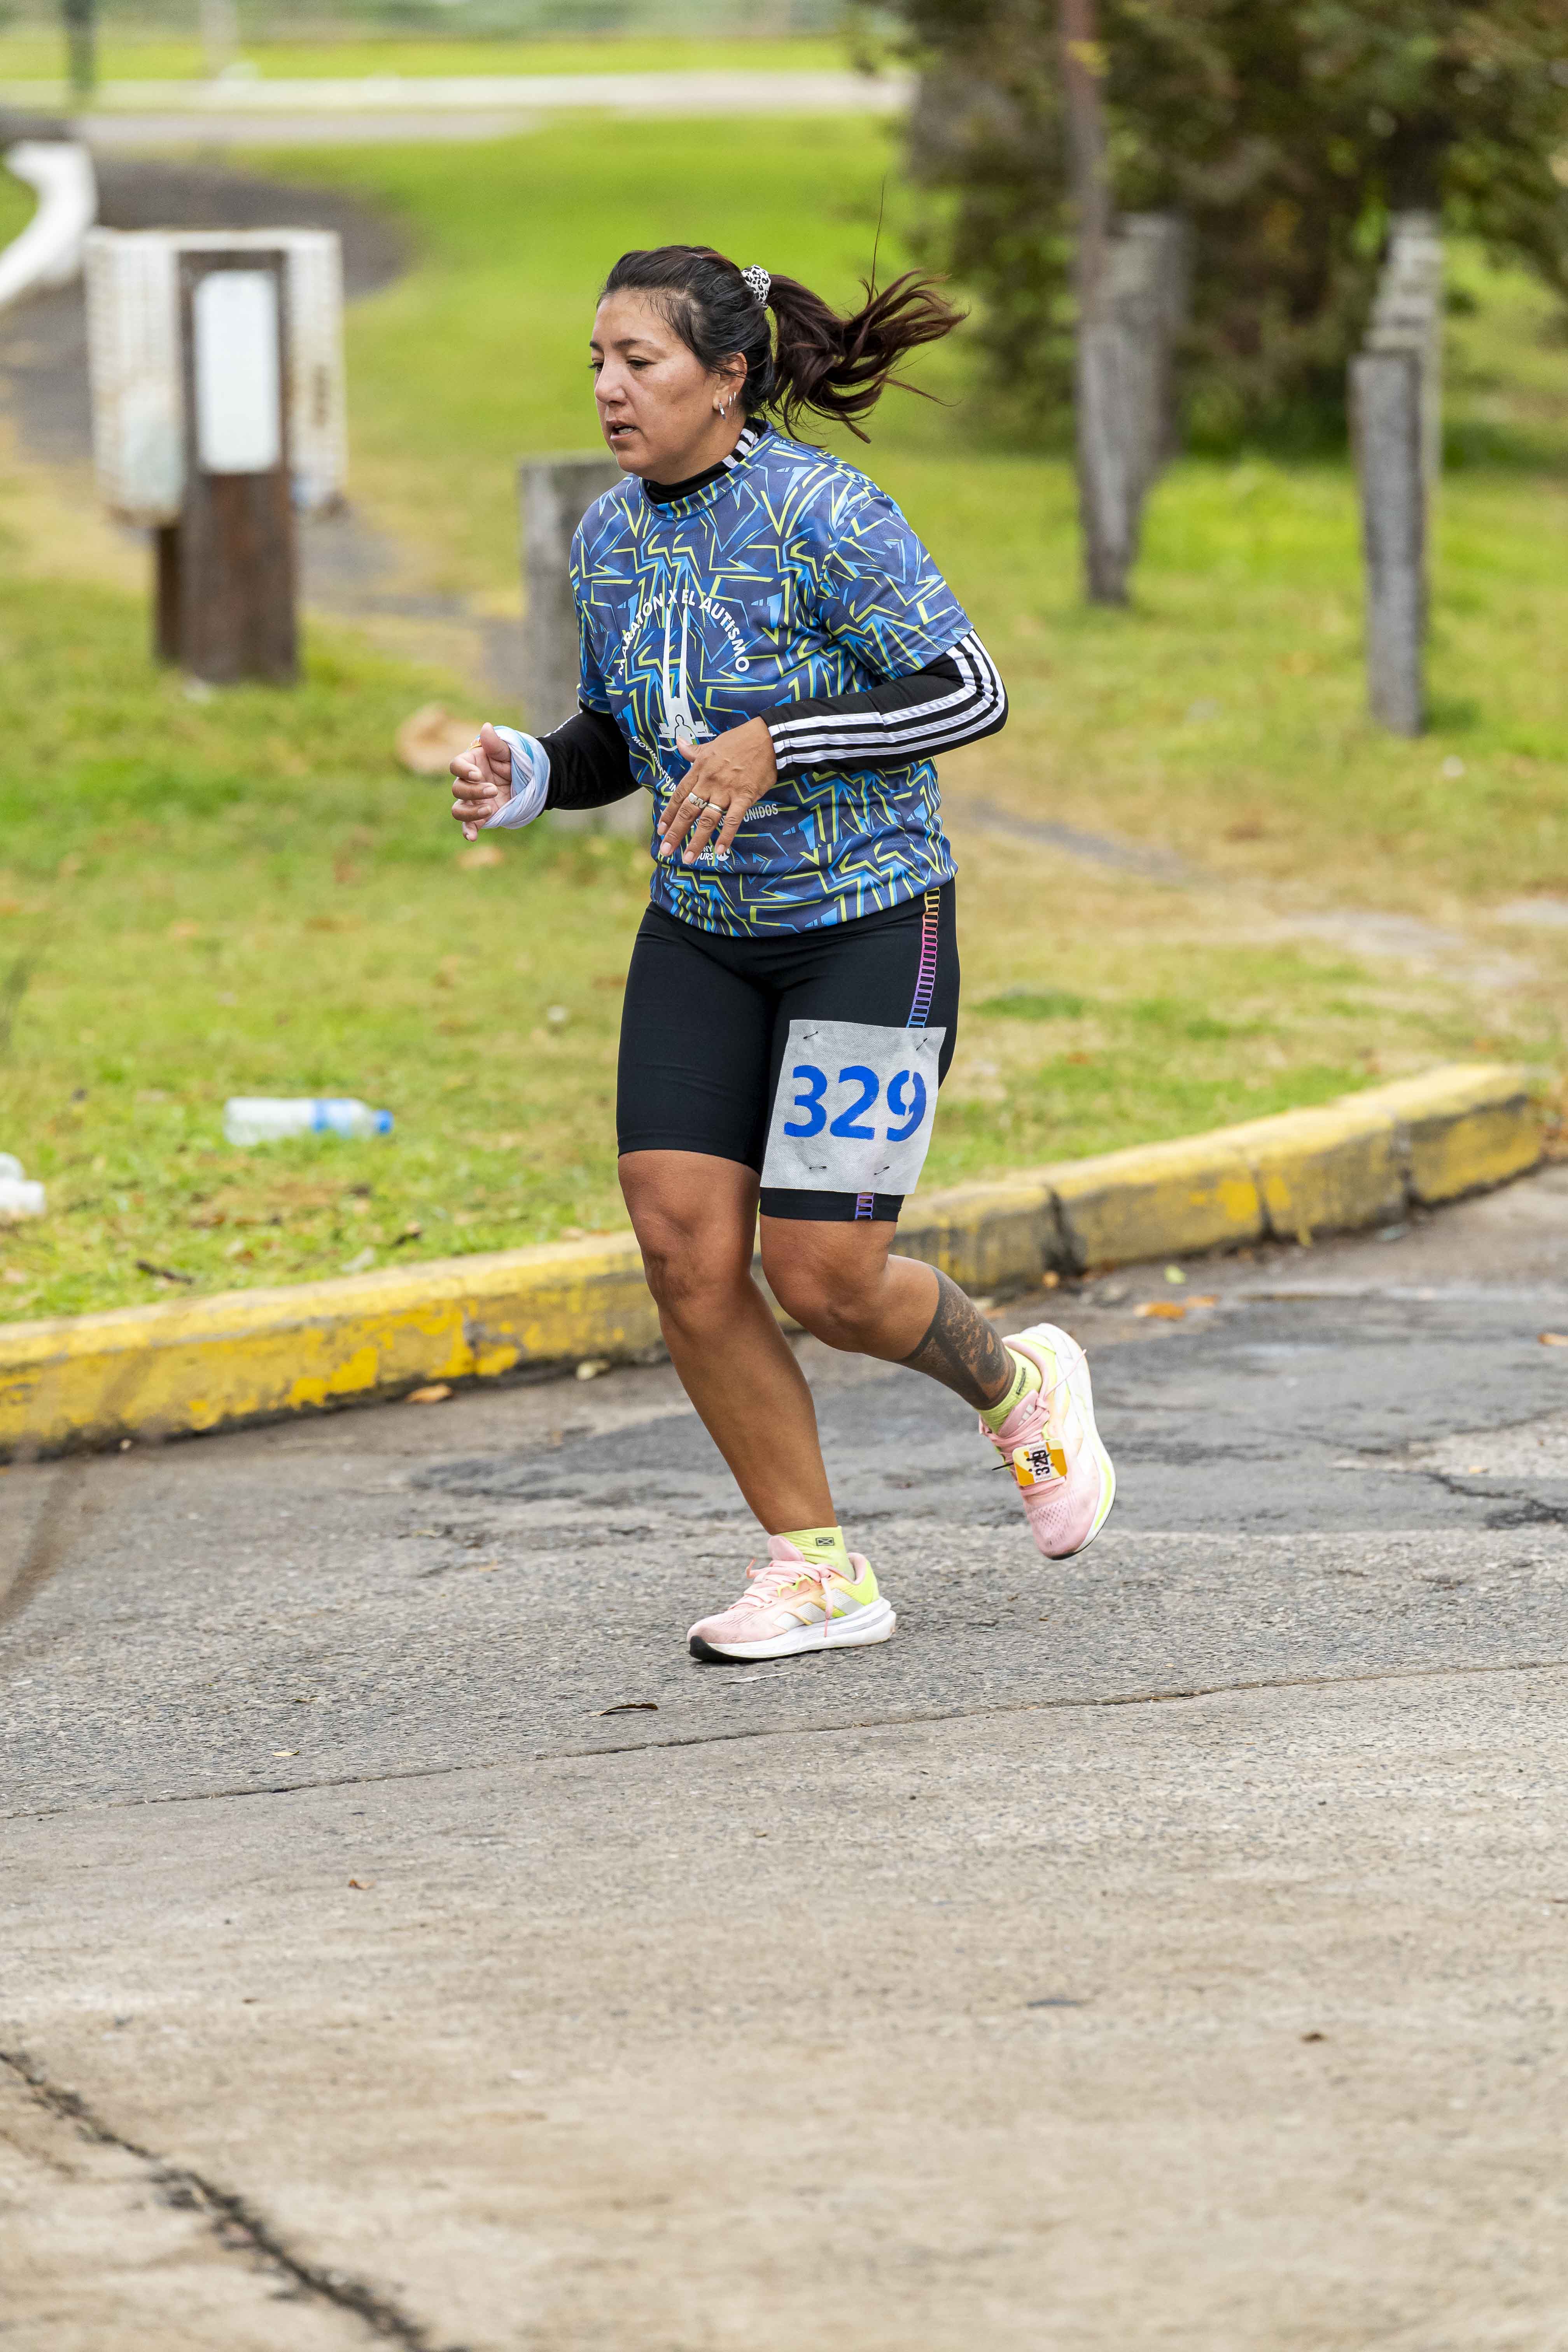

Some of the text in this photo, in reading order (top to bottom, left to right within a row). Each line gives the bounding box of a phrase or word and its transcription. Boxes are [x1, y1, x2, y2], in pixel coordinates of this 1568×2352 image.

[667, 589, 678, 604] X
[682, 589, 695, 606] EL
[698, 597, 749, 672] AUTISMO
[743, 803, 778, 822] UNIDOS
[784, 1065, 926, 1142] 329
[1032, 1450, 1050, 1476] 329
